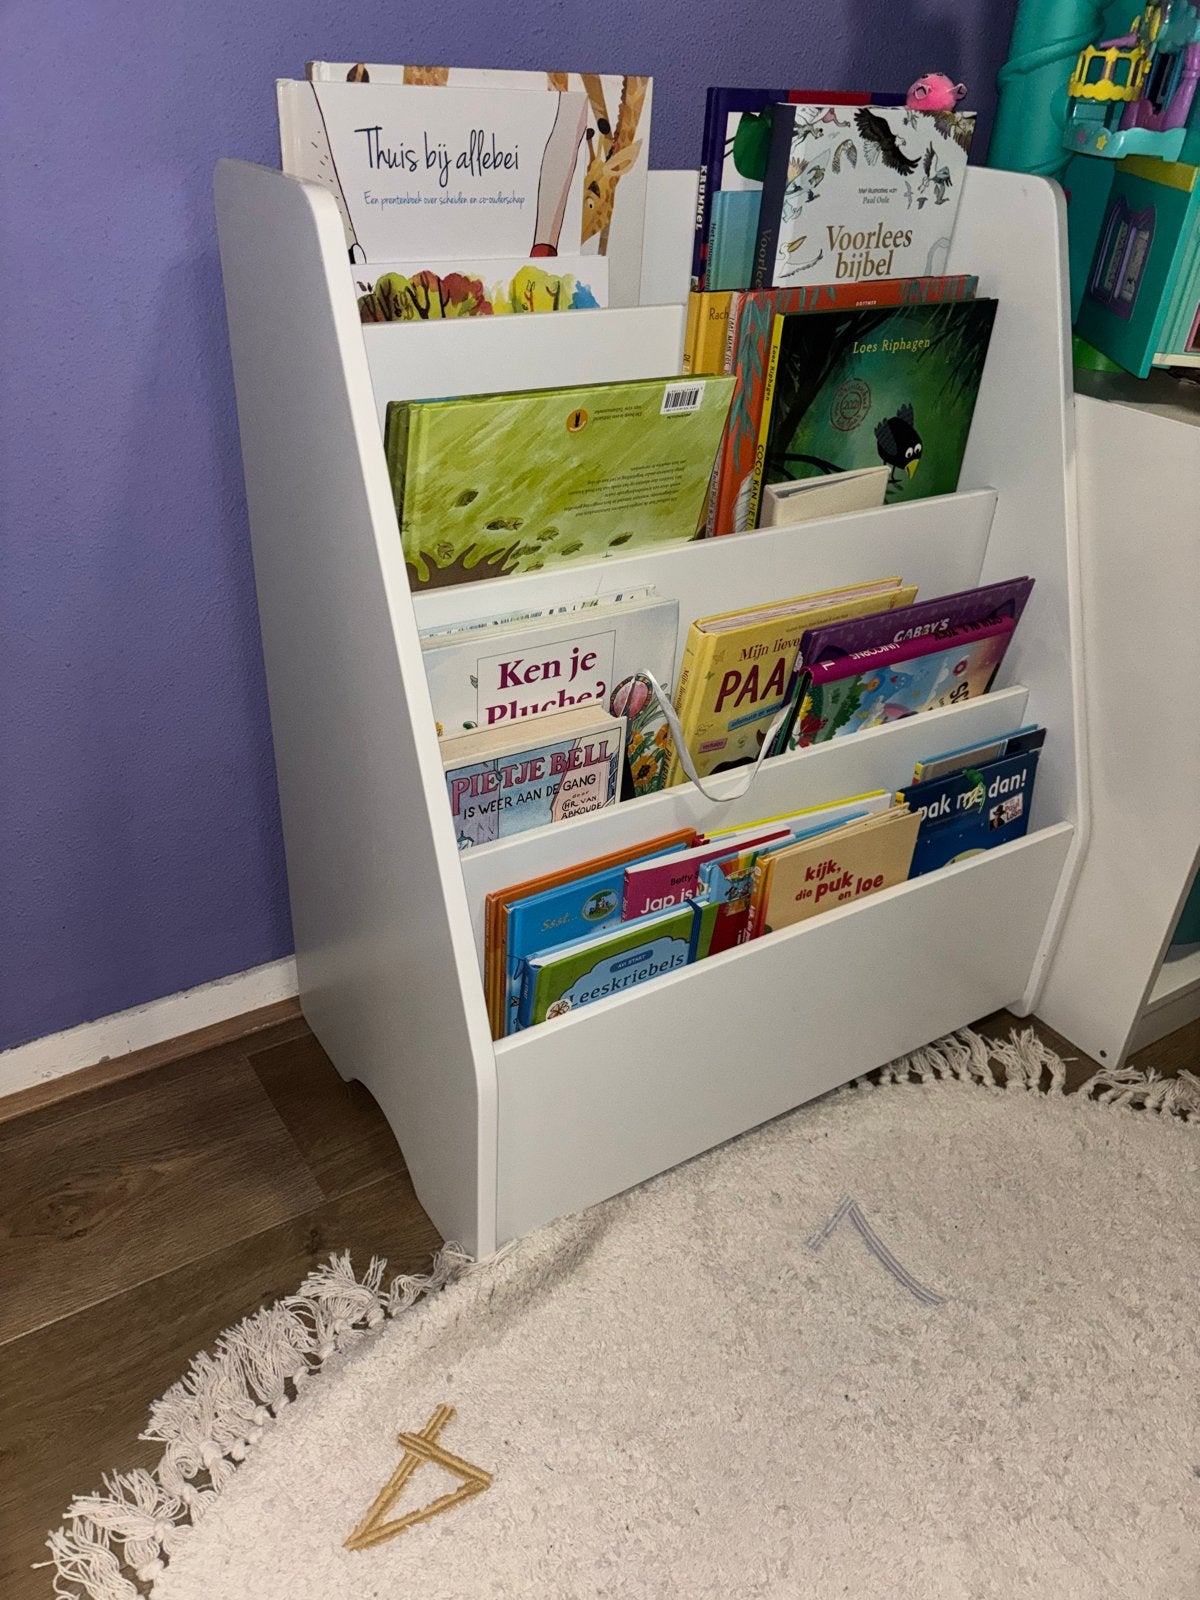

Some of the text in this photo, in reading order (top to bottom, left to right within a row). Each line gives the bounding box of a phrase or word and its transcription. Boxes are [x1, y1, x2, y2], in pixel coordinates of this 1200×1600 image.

[354, 125, 519, 188] Thuis bij allebei
[364, 190, 379, 205] Een
[381, 191, 422, 211] prentenboek
[423, 197, 437, 205] over
[439, 190, 468, 205] scheiden
[479, 190, 526, 209] co-ouderschap
[709, 223, 717, 238] Het
[826, 222, 913, 251] Voorlees
[835, 249, 894, 282] bijbel
[853, 337, 930, 354] Loes Riphagen
[765, 365, 775, 401] Riphagen
[754, 444, 765, 476] COCO
[751, 480, 760, 500] KAN
[739, 643, 769, 662] Mijn
[497, 647, 597, 690] Ken je
[714, 657, 786, 713] PAA
[451, 740, 614, 817] PIETJE BELL
[988, 768, 1027, 799] dan!
[463, 774, 597, 819] IS WEER AAN DE GANG
[561, 802, 602, 820] ABKOUDE
[580, 795, 597, 804] VAN
[670, 874, 693, 886] Betty
[805, 859, 841, 882] kijk,
[641, 894, 675, 914] Jap
[680, 888, 693, 902] is
[795, 871, 884, 903] die puk en loe
[569, 953, 685, 1007] Leeskriebels
